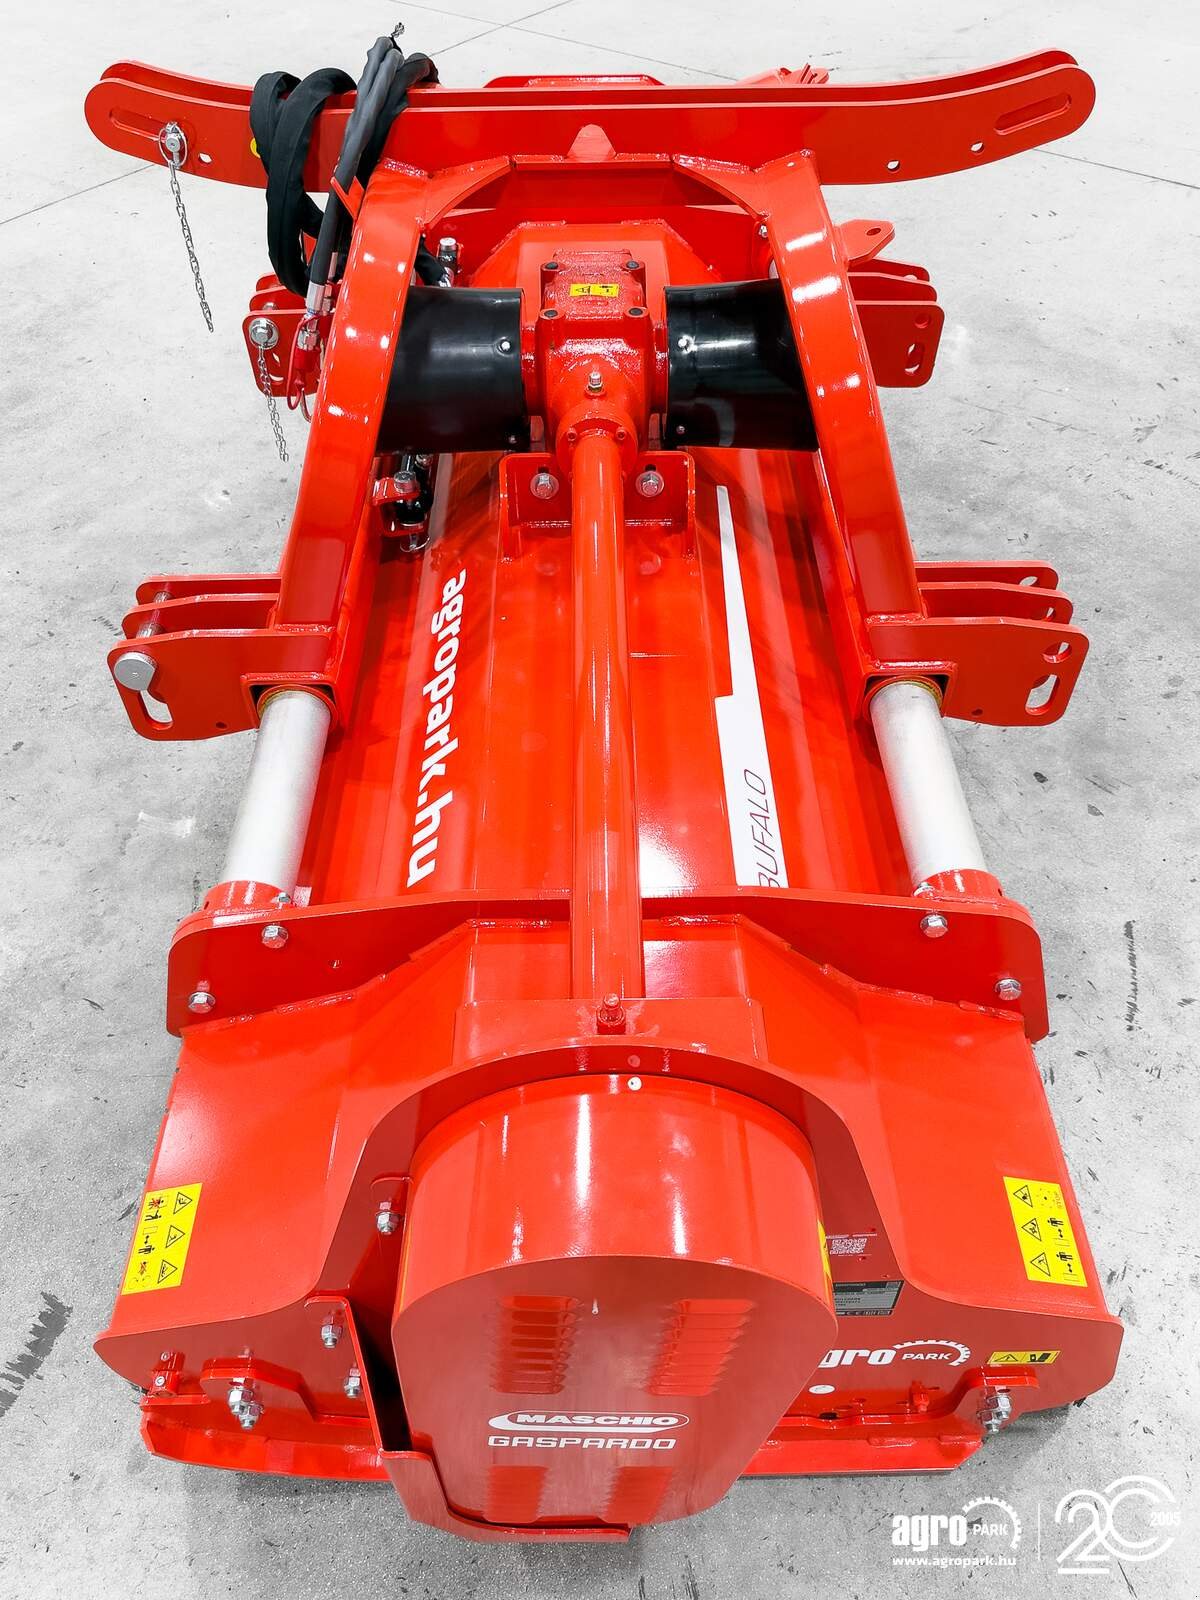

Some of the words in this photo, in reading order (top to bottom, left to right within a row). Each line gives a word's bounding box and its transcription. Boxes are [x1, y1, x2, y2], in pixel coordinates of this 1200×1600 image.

[406, 568, 466, 888] agropark.hu
[818, 1349, 896, 1368] gro
[902, 1353, 952, 1361] PARK
[516, 1414, 679, 1425] MASCHIO
[488, 1435, 677, 1450] GASPARDO
